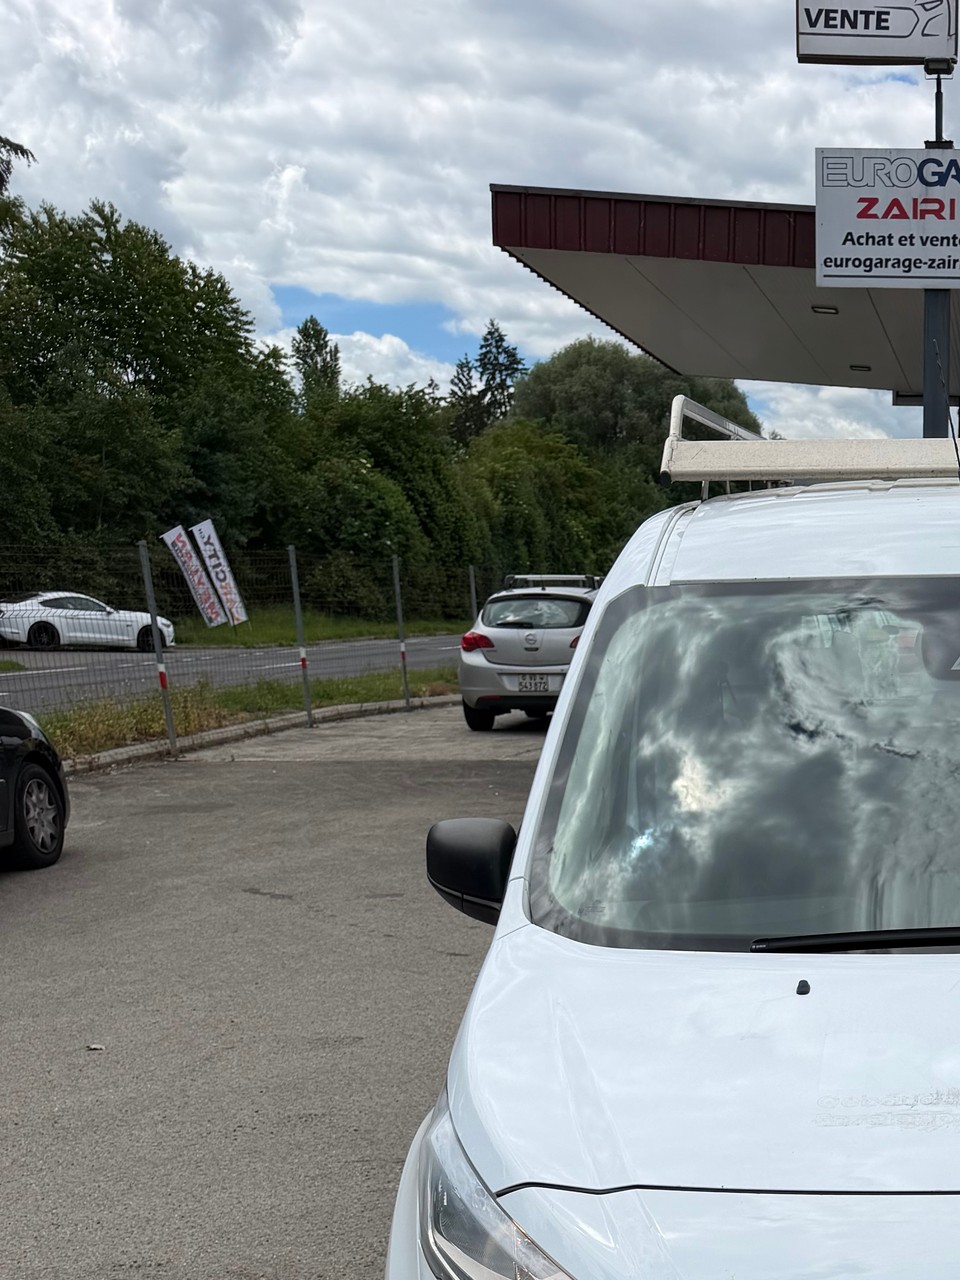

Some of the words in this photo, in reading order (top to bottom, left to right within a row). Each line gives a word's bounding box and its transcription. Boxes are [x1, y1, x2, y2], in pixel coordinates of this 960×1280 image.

[804, 8, 891, 31] VENTE
[856, 197, 956, 221] ZAIRI
[842, 231, 894, 247] Achat
[898, 234, 915, 247] et
